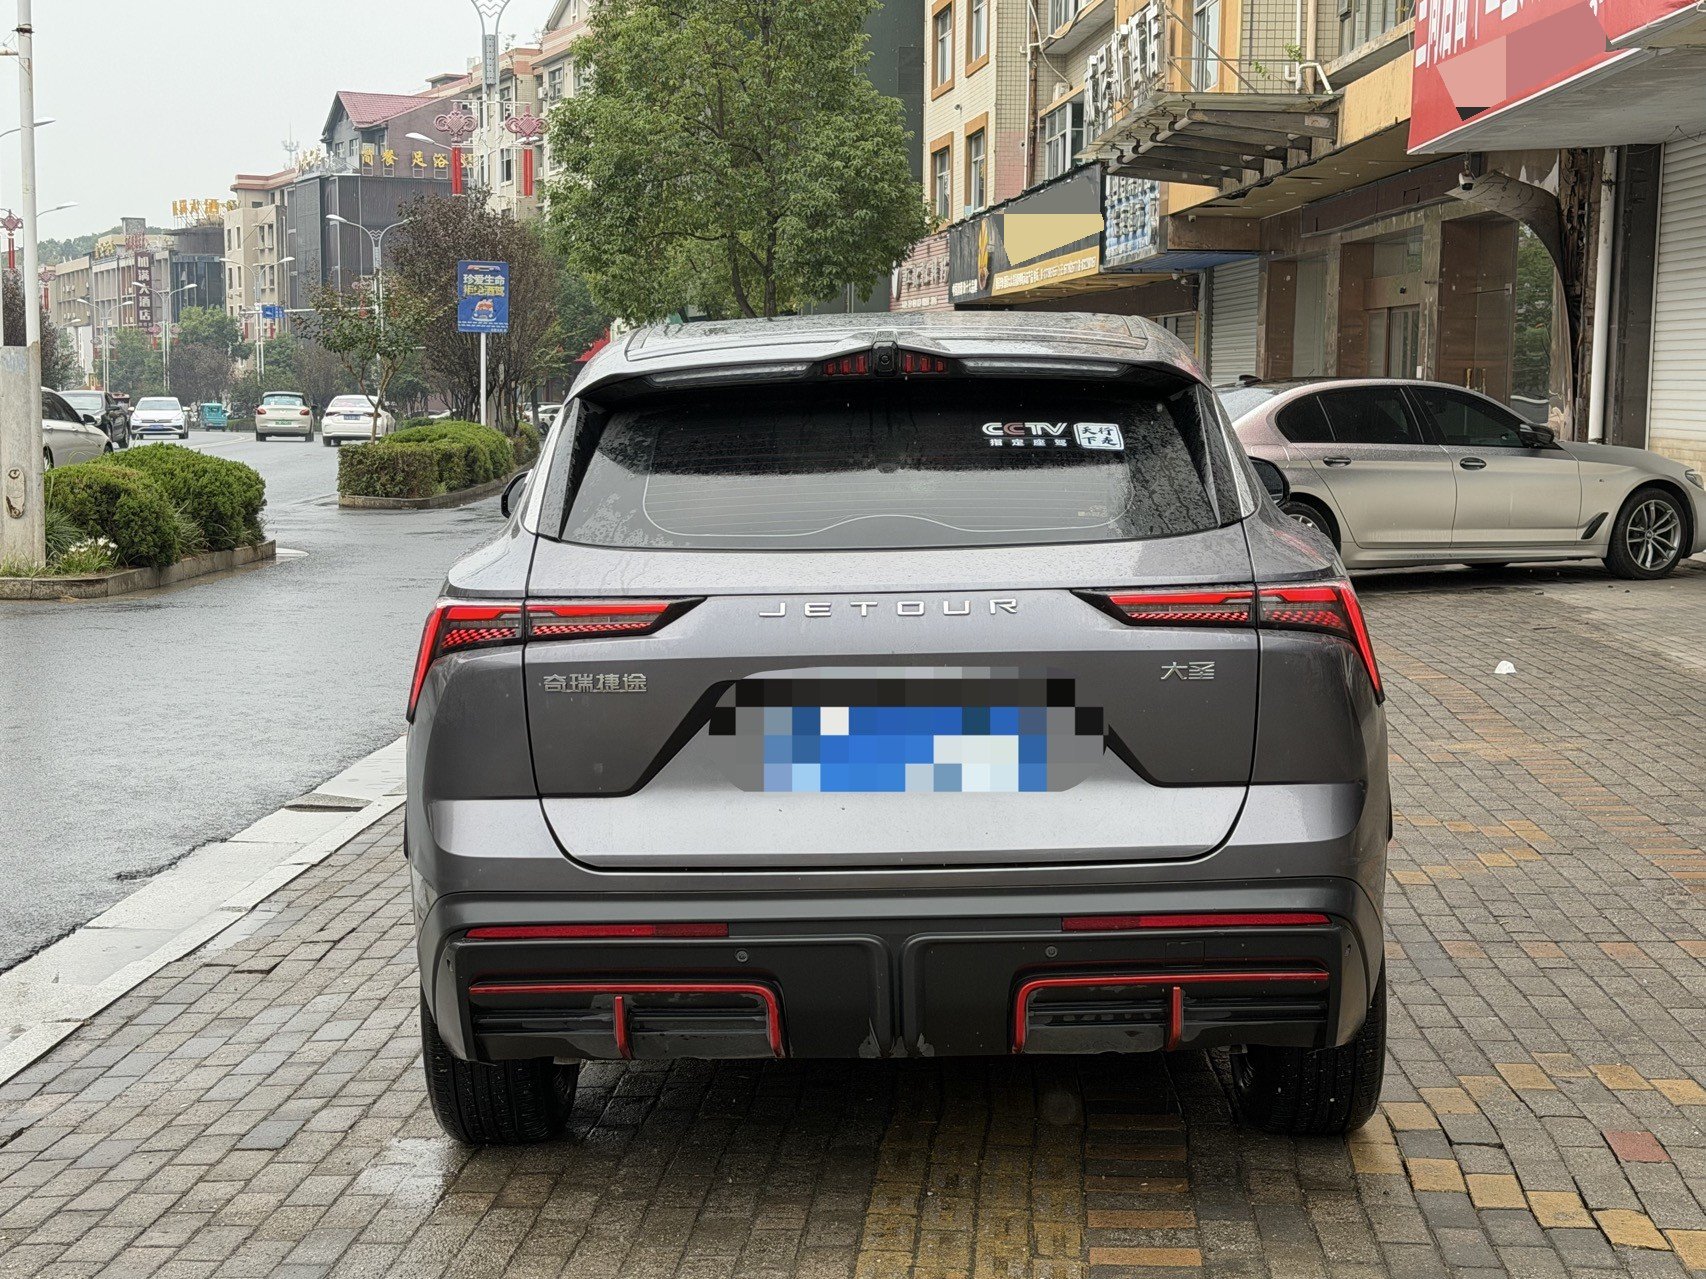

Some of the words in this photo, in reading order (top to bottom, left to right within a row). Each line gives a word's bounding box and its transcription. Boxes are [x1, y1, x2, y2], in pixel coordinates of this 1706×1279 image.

[361, 148, 398, 167] 简餐
[411, 150, 449, 168] 足浴
[463, 274, 505, 285] 珍爱生命
[982, 422, 1067, 436] CCTV
[989, 438, 1067, 447] 指定座驾
[759, 599, 1018, 618] JETOUR
[1161, 661, 1215, 680] 大圣
[543, 673, 647, 692] 奇瑞捷途
